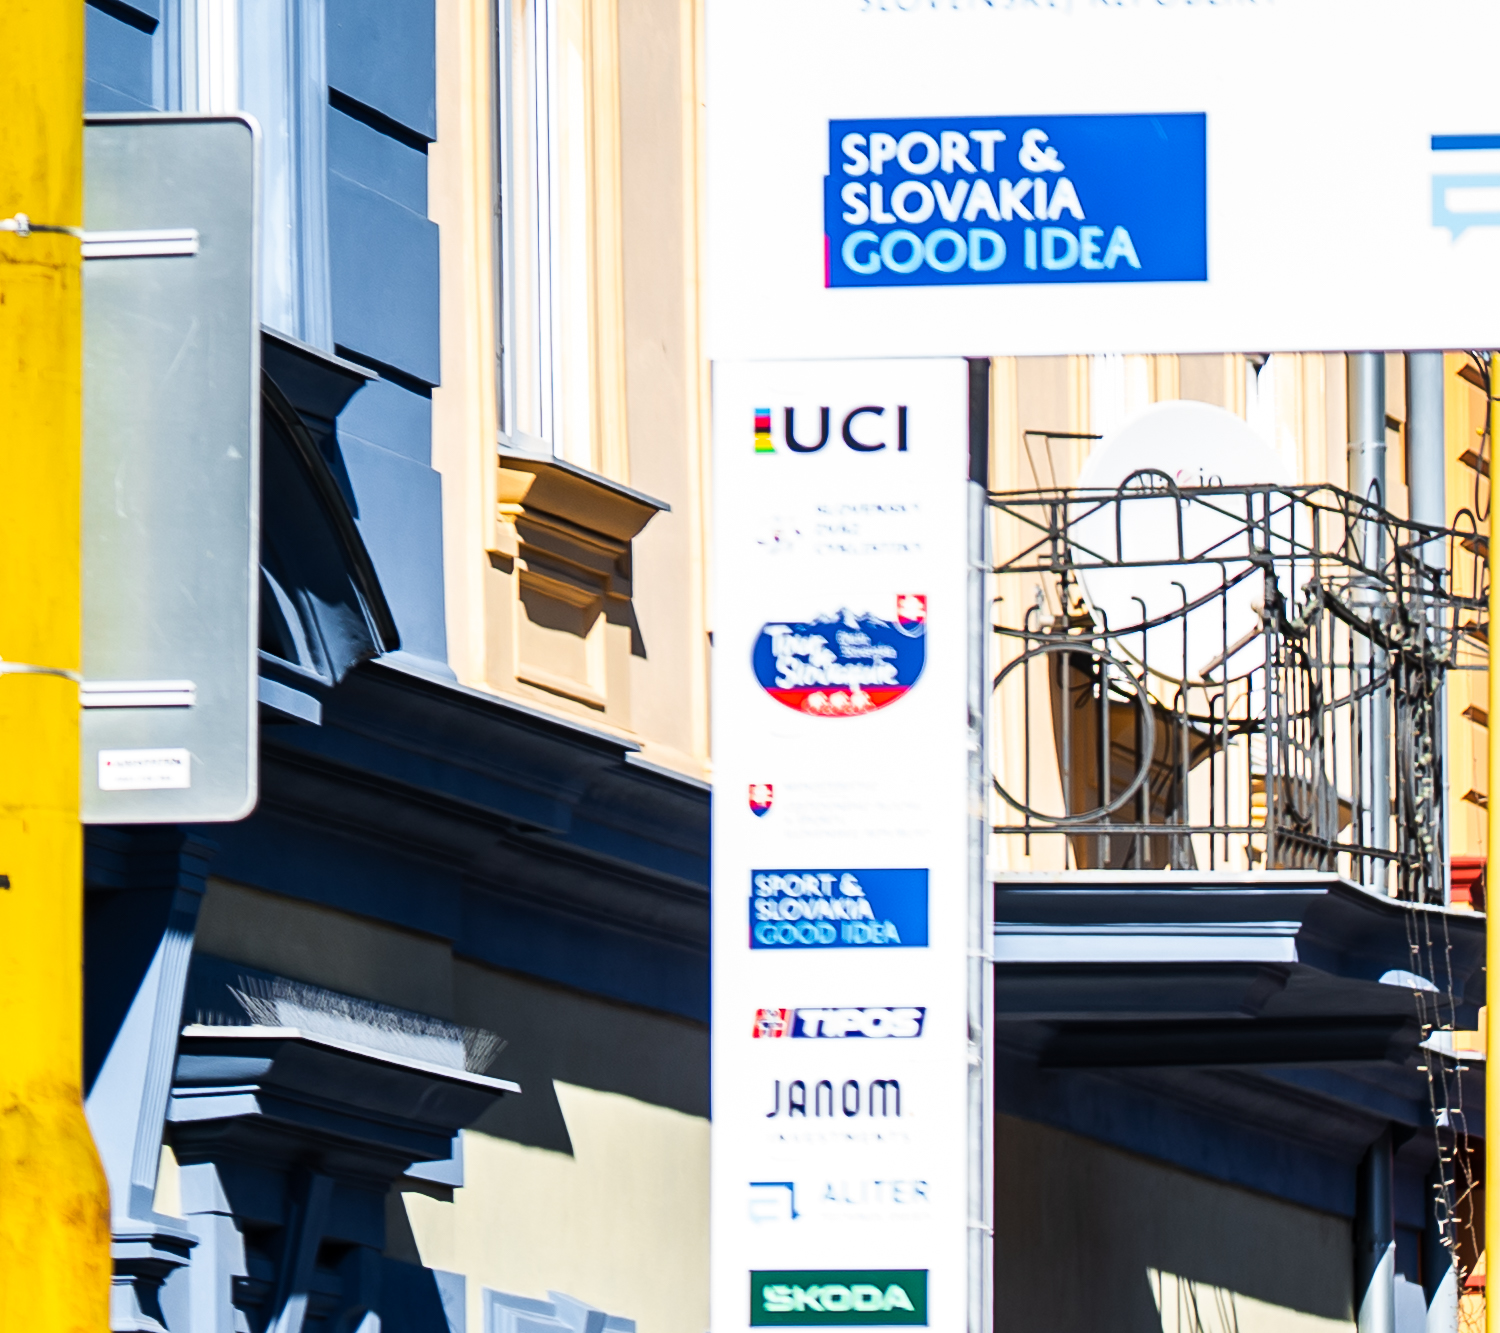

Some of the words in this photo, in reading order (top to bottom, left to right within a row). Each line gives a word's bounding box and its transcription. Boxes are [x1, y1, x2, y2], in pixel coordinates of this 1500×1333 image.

[840, 129, 1008, 176] SPORT
[1018, 127, 1065, 174] &
[840, 177, 1087, 227] SLOVAKIA
[840, 228, 1013, 277] GOOD
[1021, 224, 1142, 273] IDEA
[783, 405, 909, 454] UCI
[754, 872, 838, 898] SPORT
[754, 896, 875, 921] SLOVAKIA
[797, 1007, 924, 1038] TIPOS
